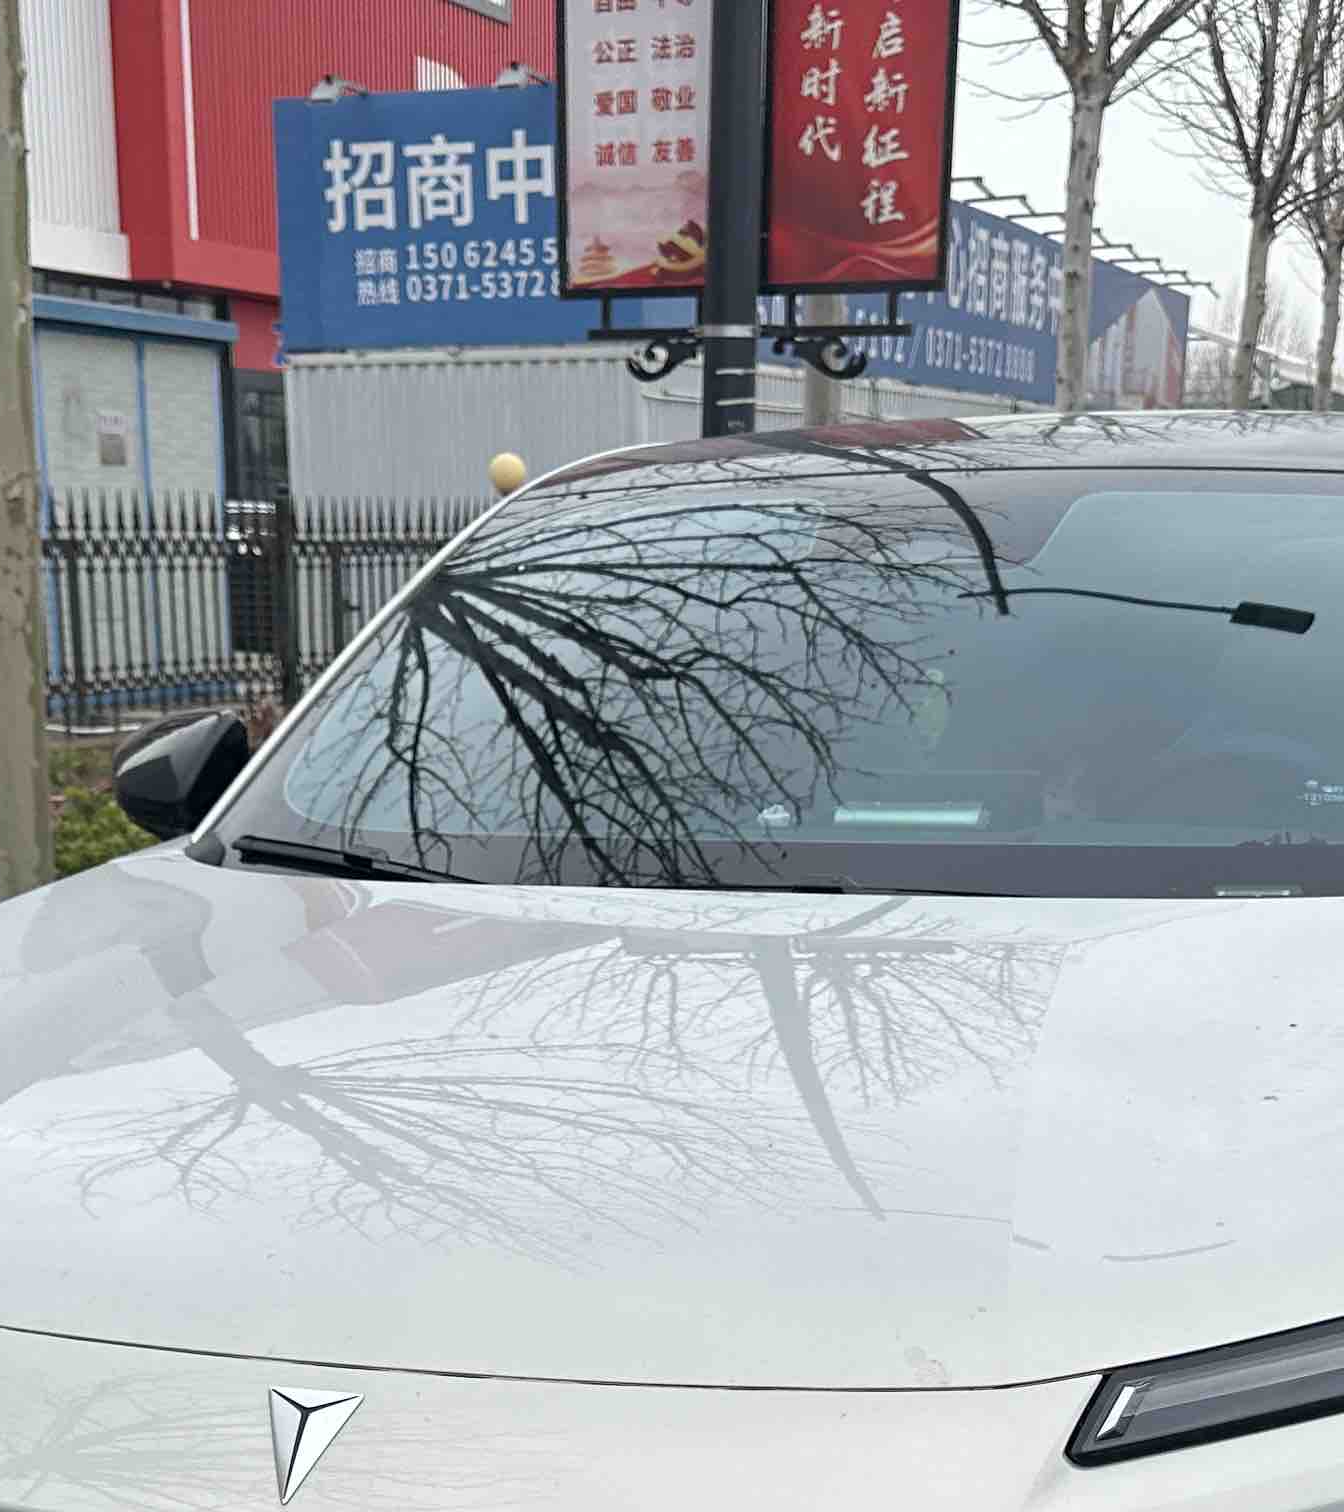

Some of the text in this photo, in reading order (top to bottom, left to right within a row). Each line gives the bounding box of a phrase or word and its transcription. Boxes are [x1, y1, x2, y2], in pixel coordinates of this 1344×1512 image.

[594, 33, 696, 64] 公正 法治
[798, 3, 844, 162] 新时代
[594, 85, 696, 117] 爱国 敬业
[595, 137, 696, 167] 诚信 友善
[323, 129, 556, 233] 招商中
